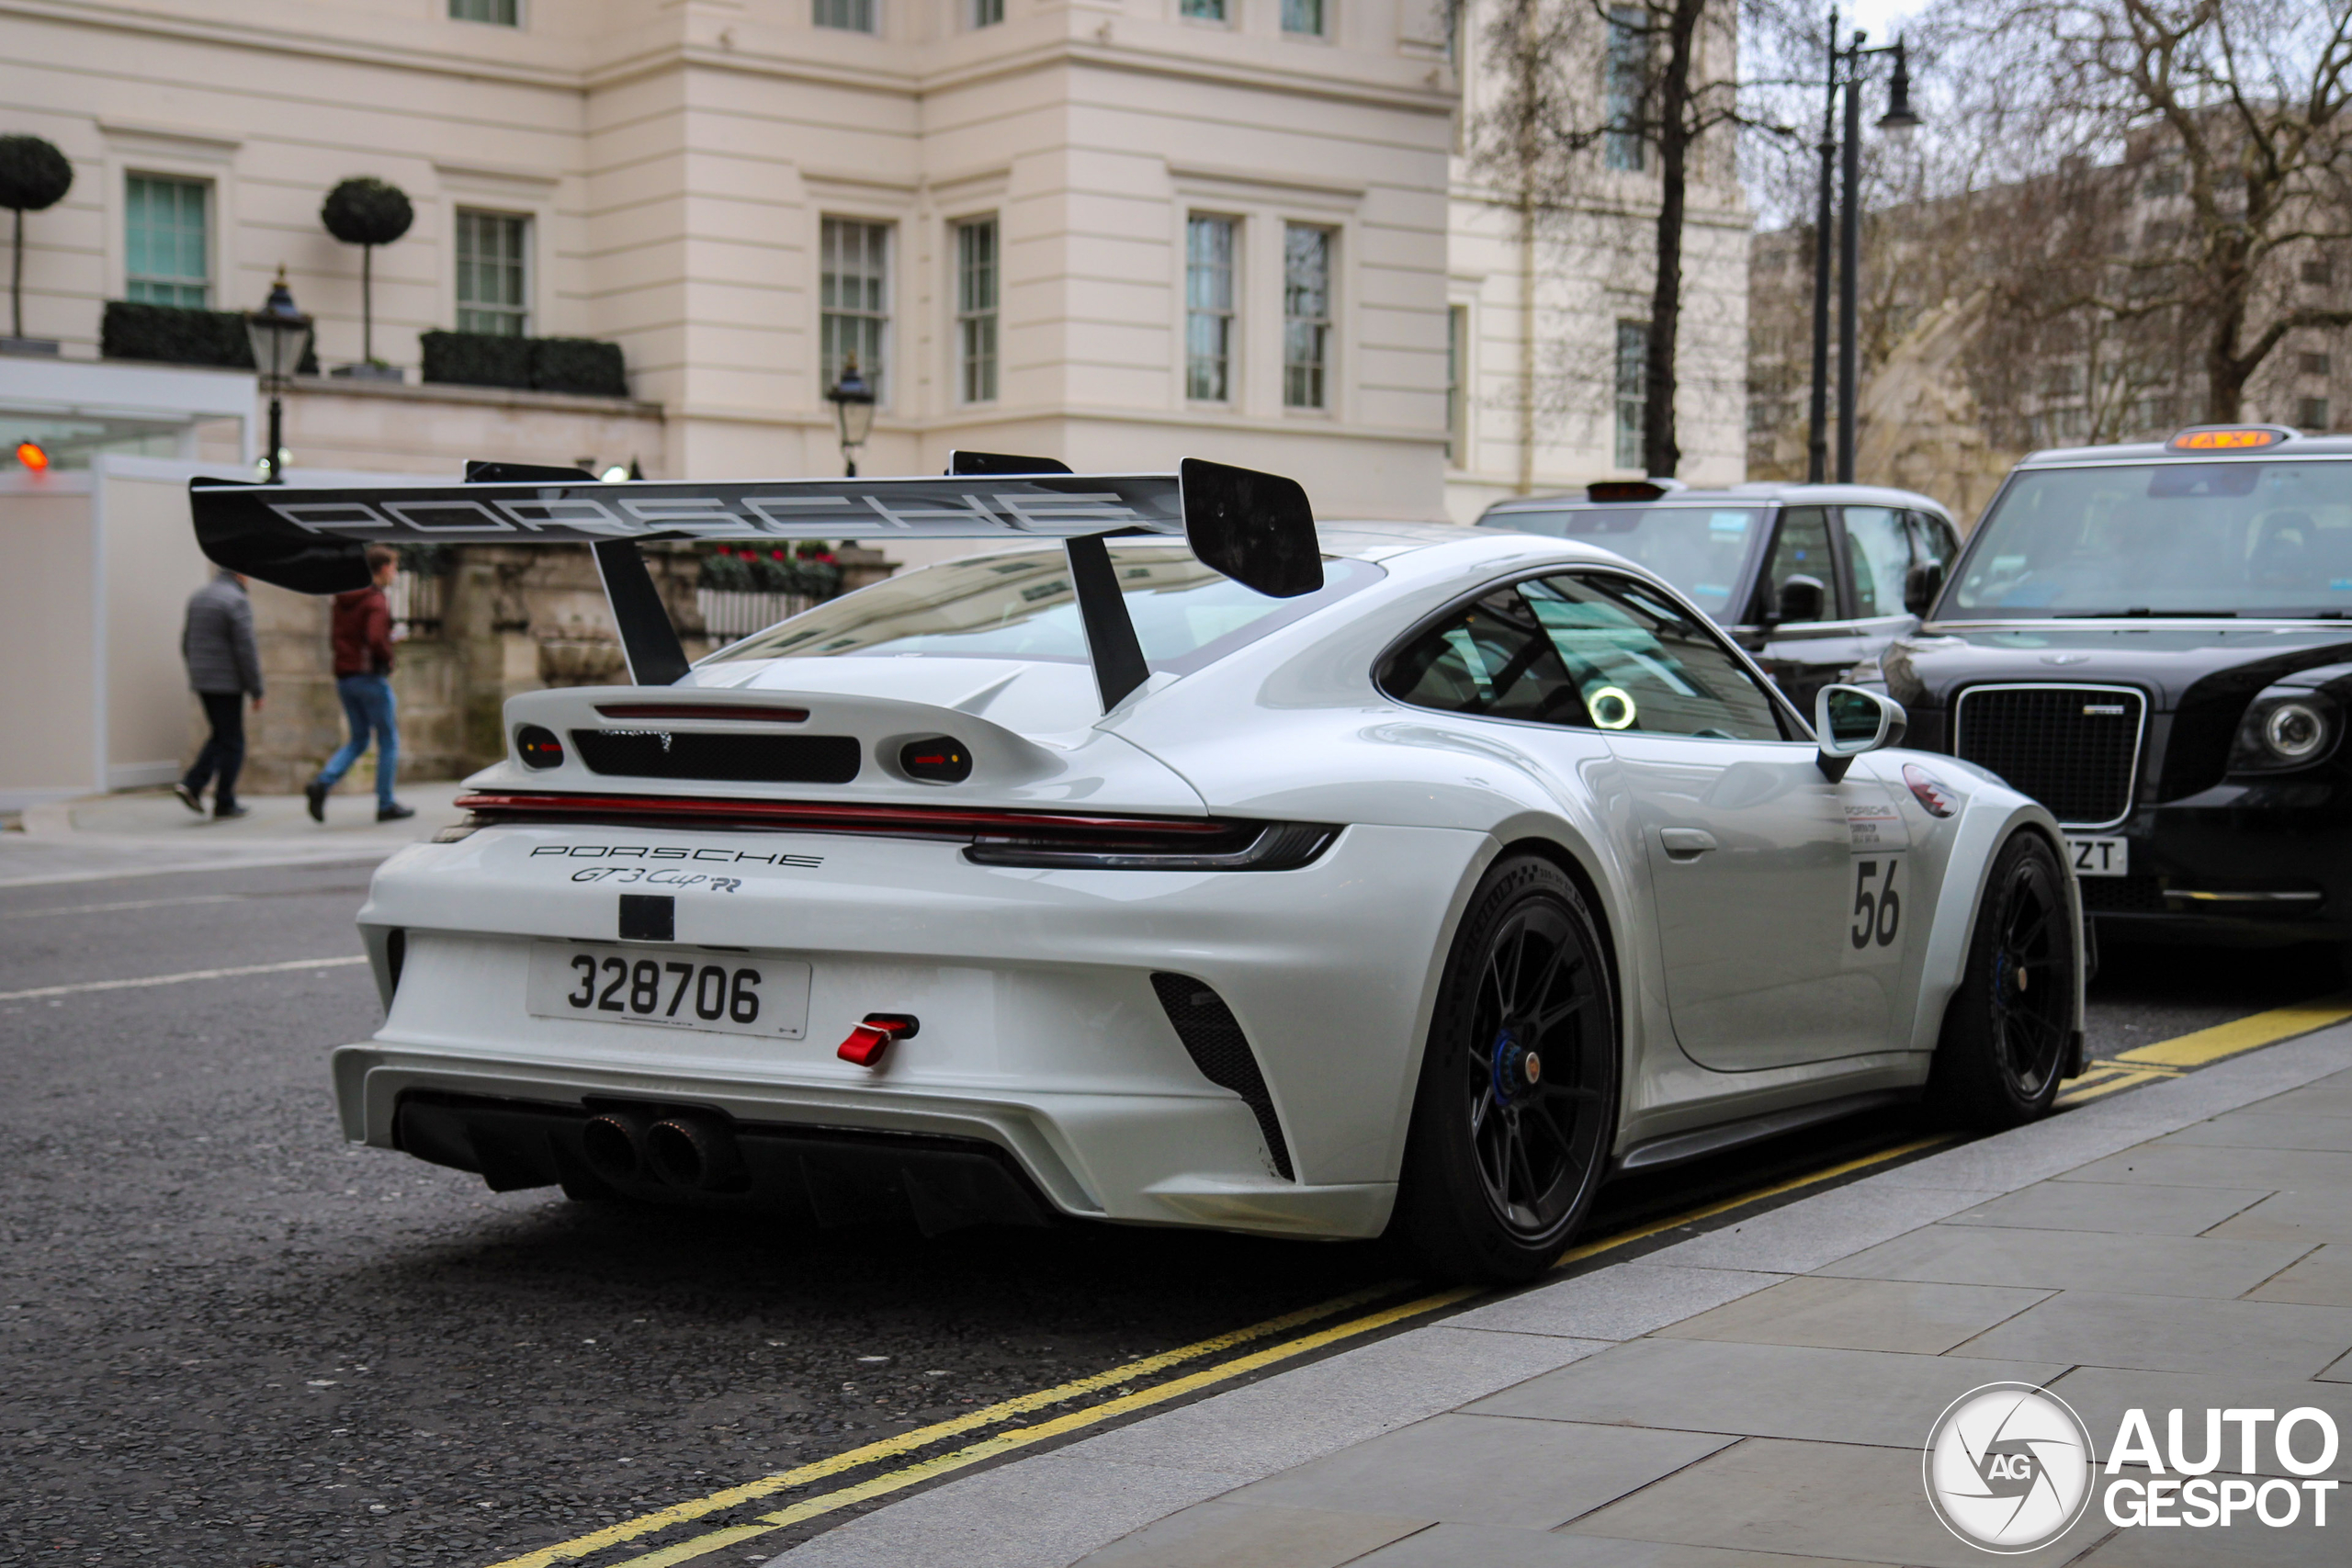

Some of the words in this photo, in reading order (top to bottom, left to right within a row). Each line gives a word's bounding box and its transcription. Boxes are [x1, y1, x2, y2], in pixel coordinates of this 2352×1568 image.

[2177, 431, 2265, 448] TAXI
[268, 492, 1151, 534] PORSCHE
[530, 846, 824, 868] PORSCHE
[2066, 841, 2115, 870] ZT
[646, 869, 707, 888] Cup
[1851, 860, 1900, 949] 56
[568, 954, 762, 1024] 328706
